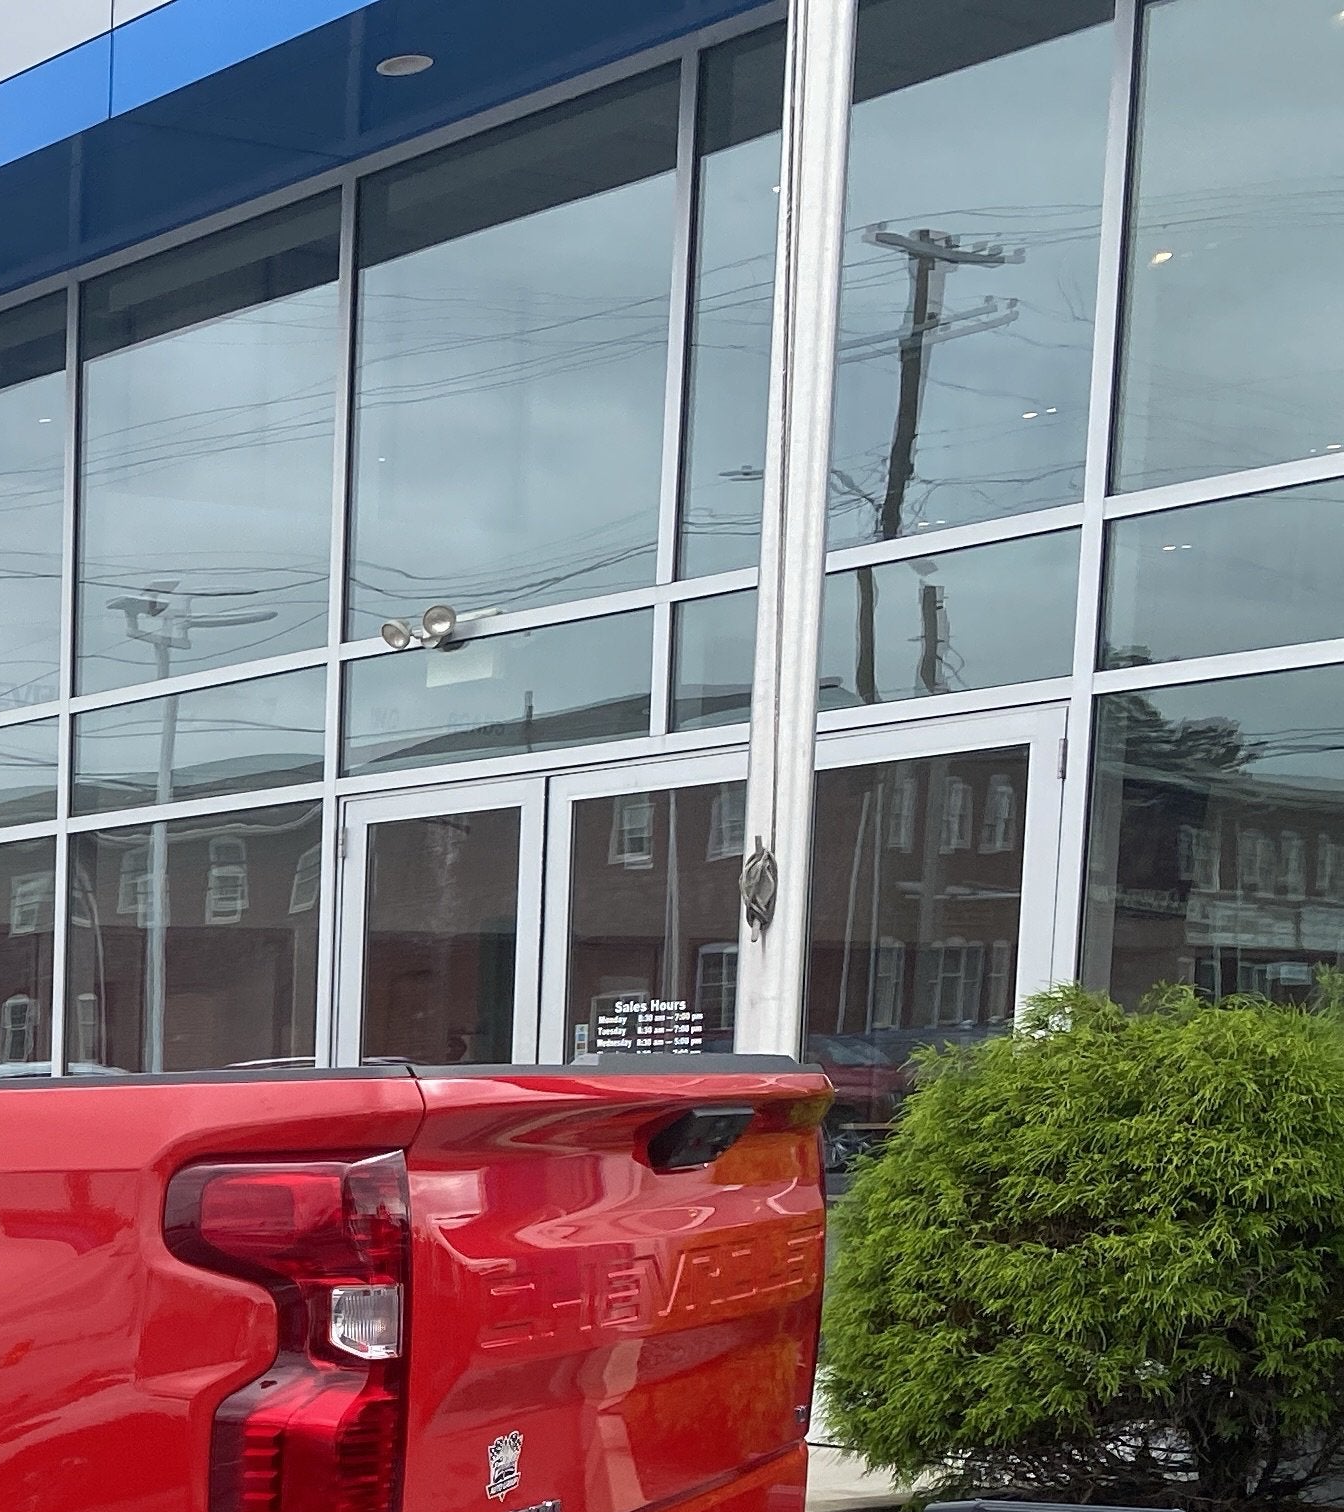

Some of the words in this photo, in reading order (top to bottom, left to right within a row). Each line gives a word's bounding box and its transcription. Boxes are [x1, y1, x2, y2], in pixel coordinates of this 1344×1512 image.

[615, 1001, 647, 1013] Sales
[650, 1000, 686, 1011] Hours
[598, 1015, 628, 1025] Monday
[597, 1027, 627, 1037] Tuesday
[596, 1039, 633, 1048] Wednesday
